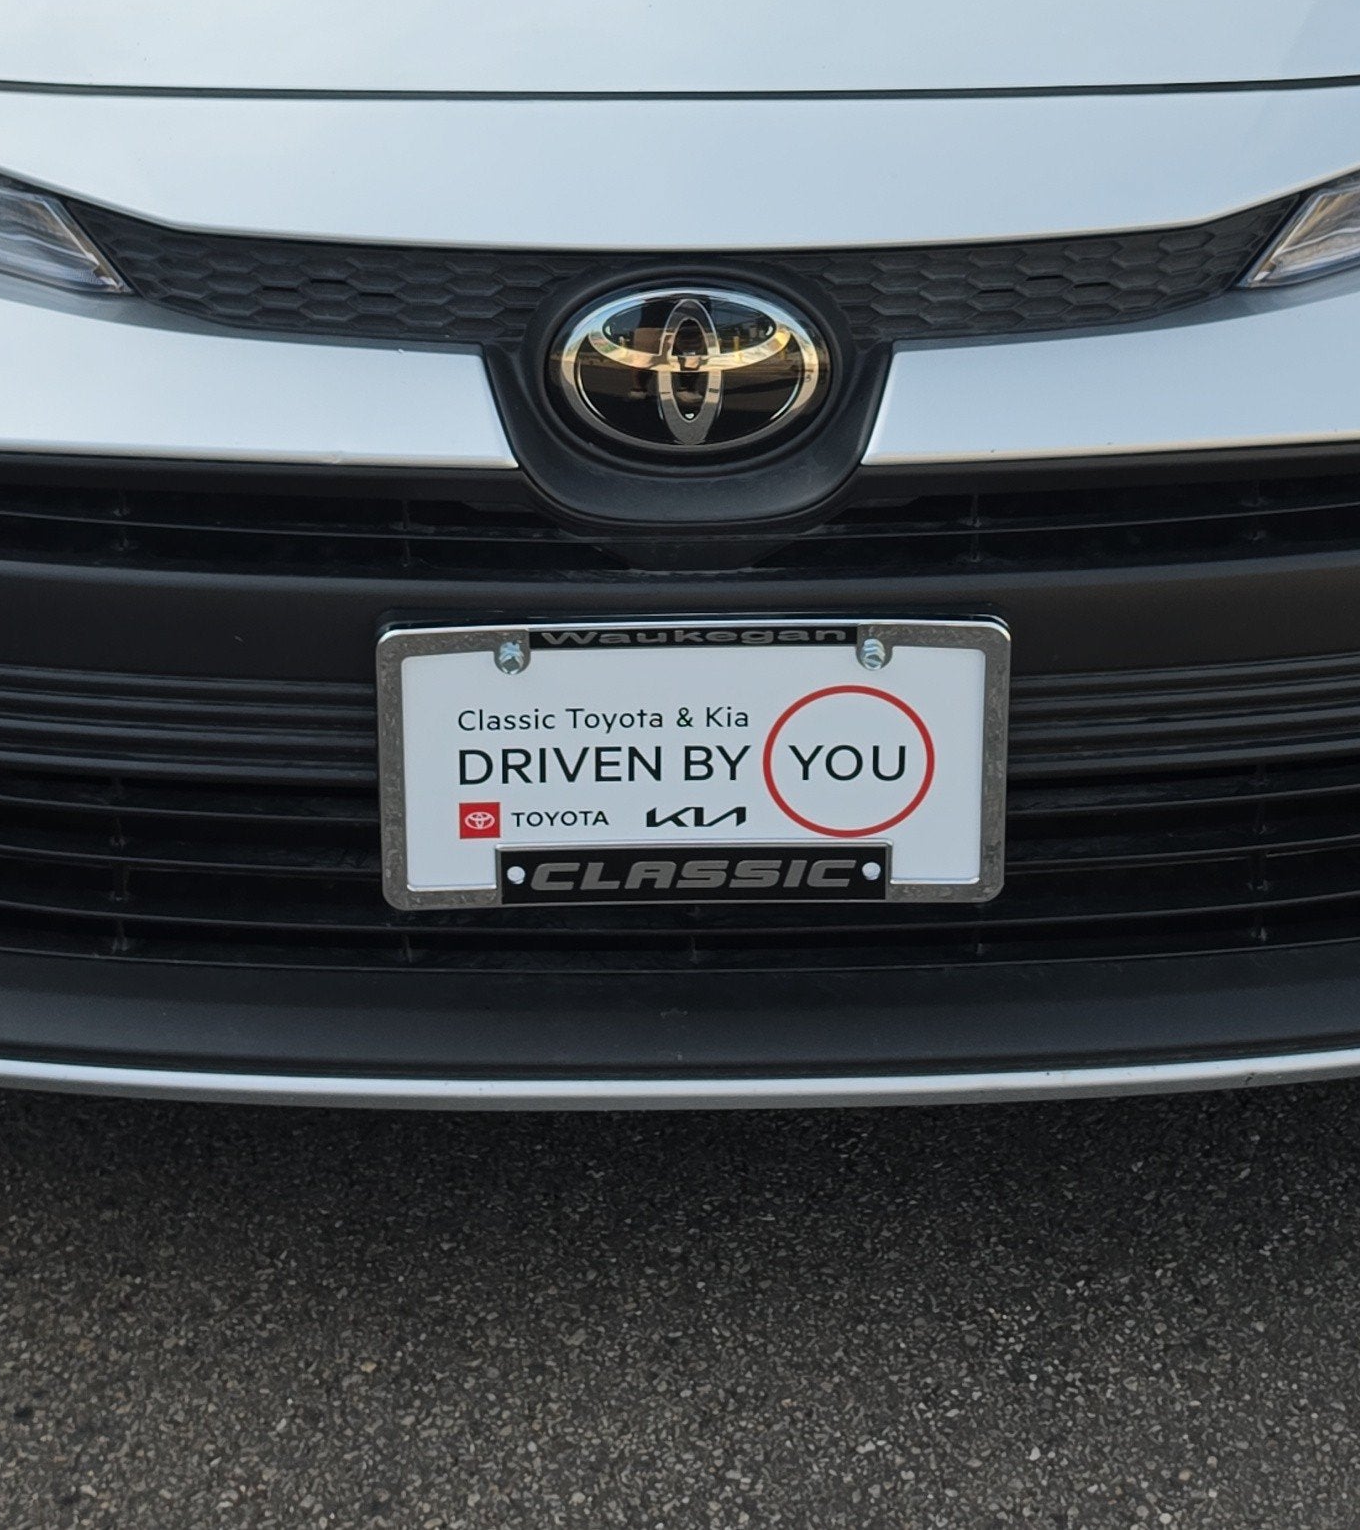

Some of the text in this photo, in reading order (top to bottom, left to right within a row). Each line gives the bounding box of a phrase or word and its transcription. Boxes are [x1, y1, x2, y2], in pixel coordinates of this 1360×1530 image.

[541, 629, 847, 645] Waukegan
[458, 706, 749, 734] Classic Toyota & Kia
[458, 744, 906, 785] DRIVEN BY YOU
[511, 810, 609, 828] TOYOTA
[530, 859, 857, 891] CLASSIC
